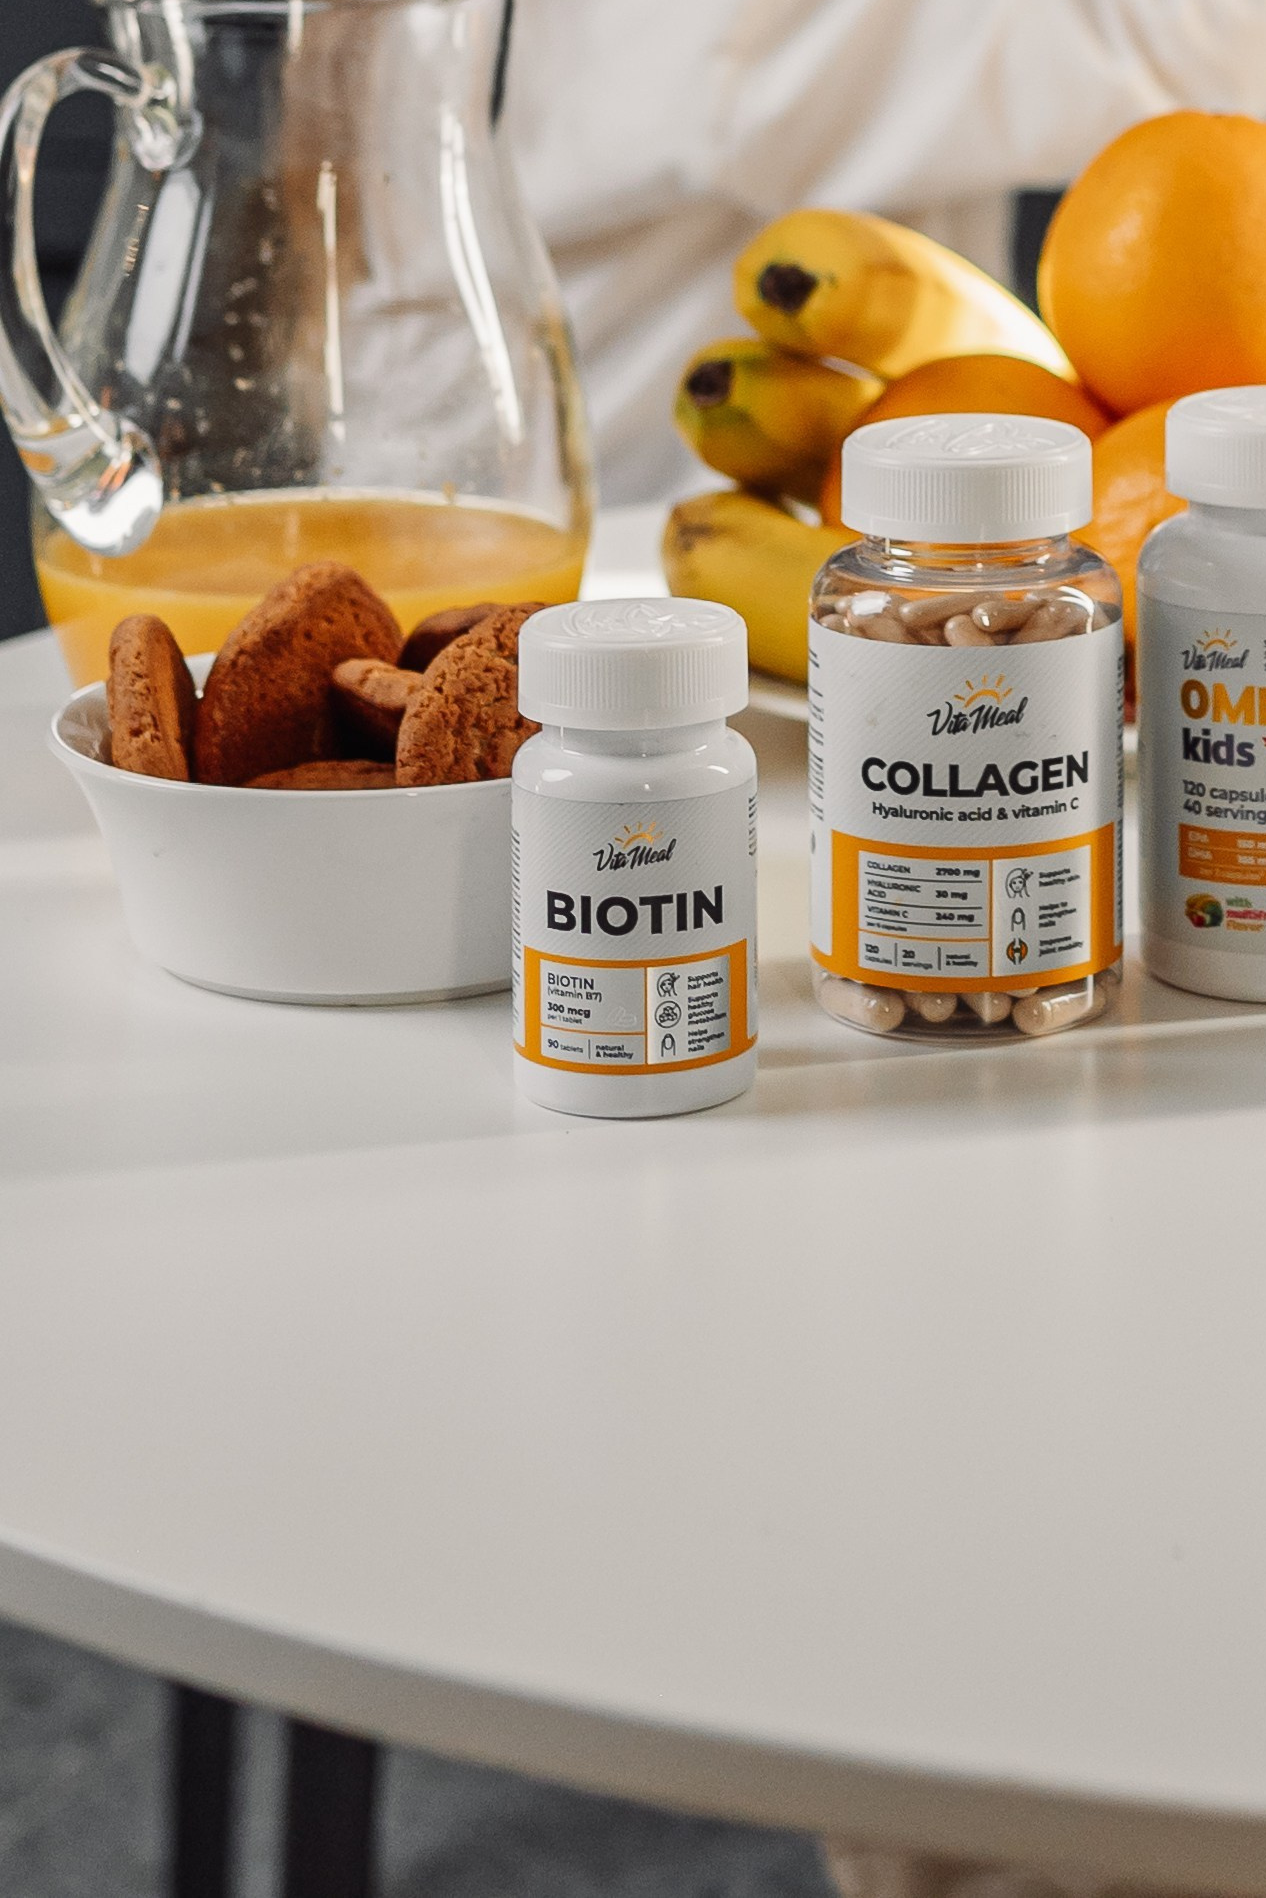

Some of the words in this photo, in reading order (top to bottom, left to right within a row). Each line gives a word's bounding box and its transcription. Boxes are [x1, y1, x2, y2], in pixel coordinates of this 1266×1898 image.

[927, 701, 971, 736] Vita
[970, 697, 1028, 734] Meal
[1182, 727, 1255, 767] kids
[861, 751, 1089, 797] COLLAGEN
[1183, 779, 1205, 797] 120
[872, 801, 954, 821] Hyaluronic
[958, 804, 992, 821] acid
[997, 807, 1008, 820] &
[1012, 800, 1066, 820] vitamin
[1070, 797, 1079, 810] C
[1183, 798, 1201, 815] 40
[593, 843, 628, 871] Vita
[629, 838, 677, 870] Meal
[867, 860, 911, 874] COLLAGEN
[963, 869, 980, 878] mg
[951, 892, 968, 900] mg
[547, 885, 723, 936] BIOTIN
[957, 914, 974, 923] mg
[547, 972, 595, 990] BIOTIN
[547, 986, 583, 999] (vitamin
[586, 991, 603, 1003] B7)
[547, 1002, 565, 1013] 300
[567, 1007, 591, 1018] mcg
[547, 1038, 559, 1049] 90
